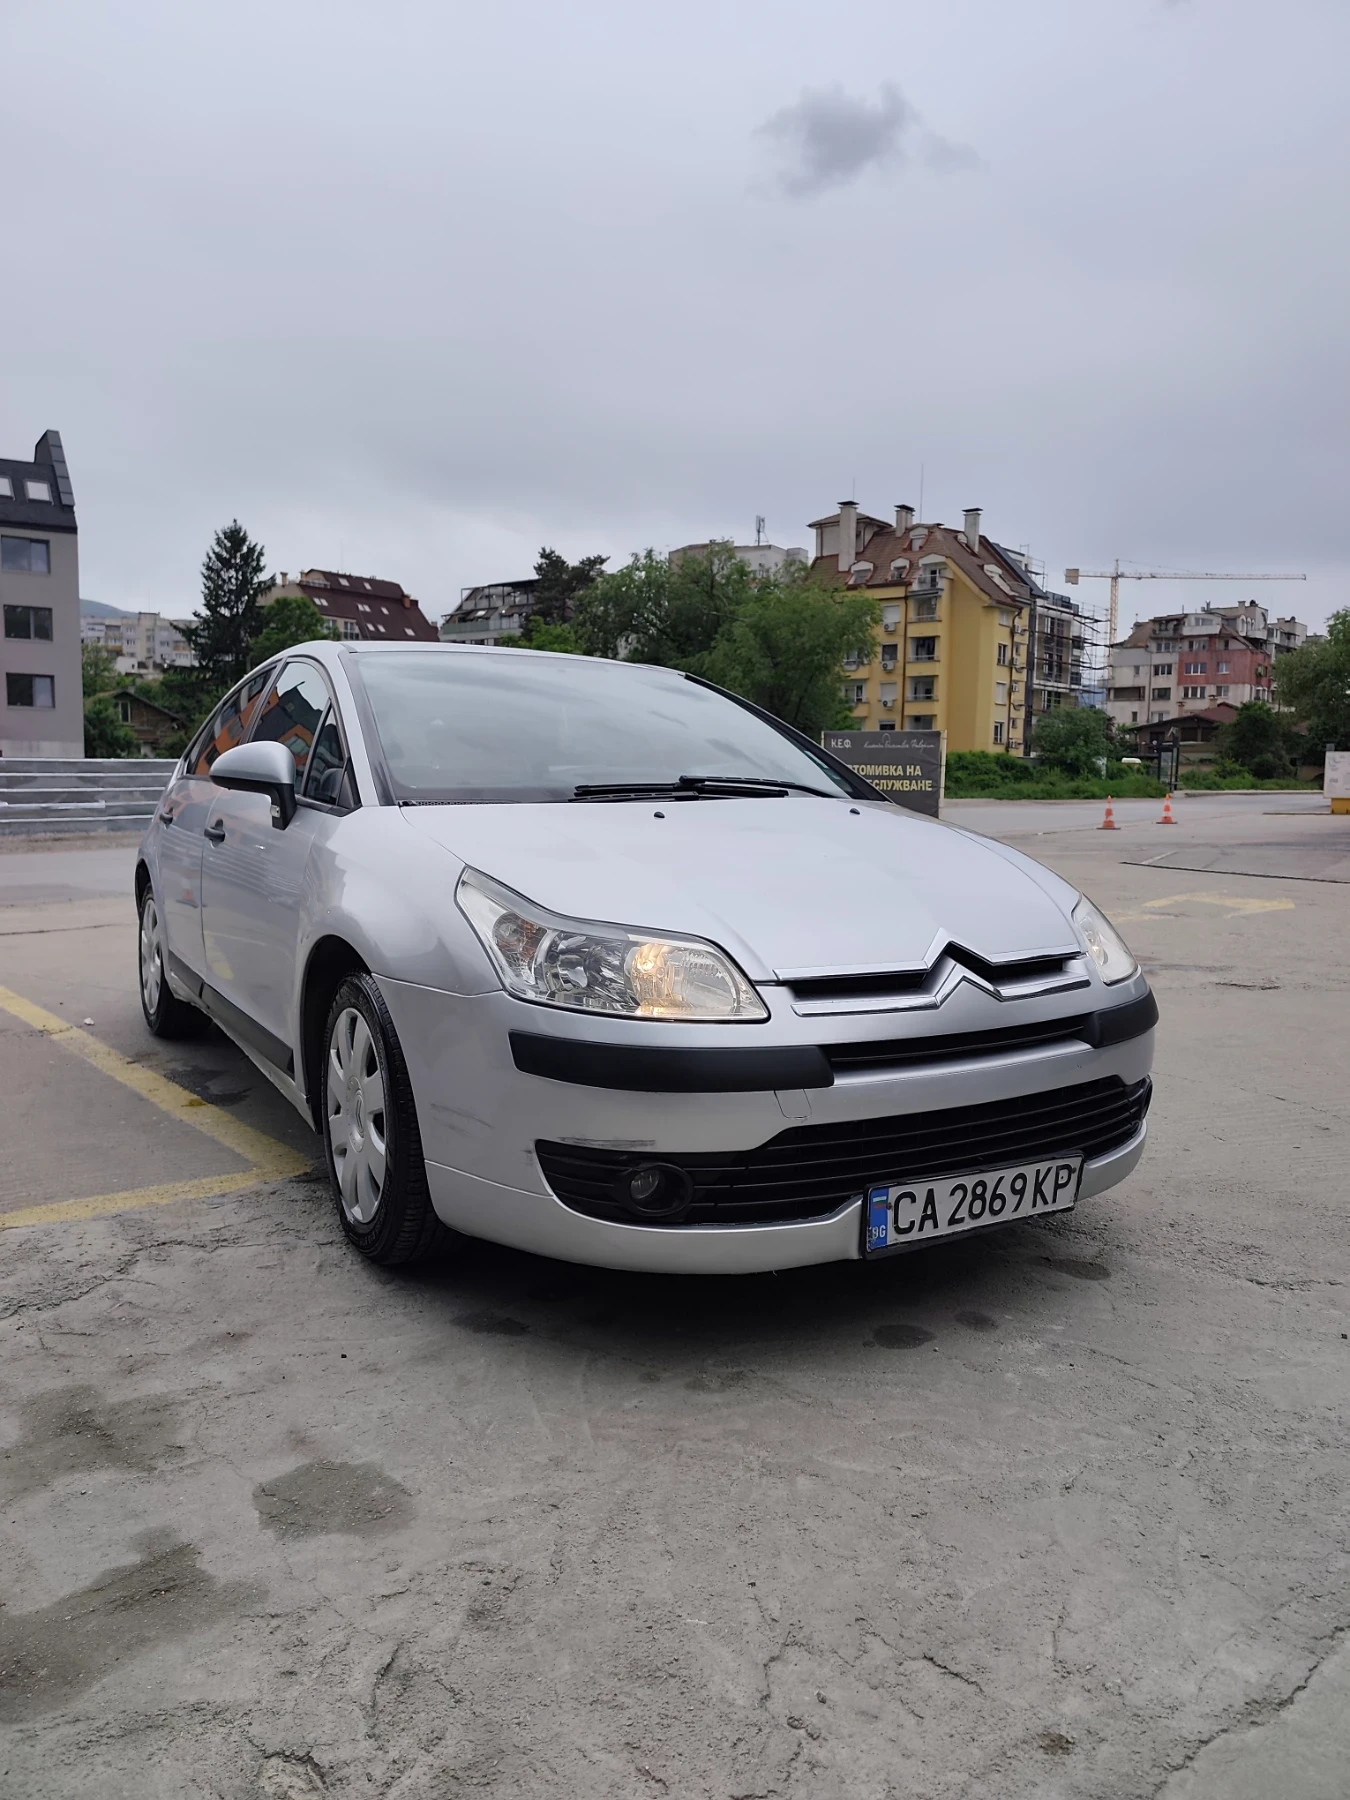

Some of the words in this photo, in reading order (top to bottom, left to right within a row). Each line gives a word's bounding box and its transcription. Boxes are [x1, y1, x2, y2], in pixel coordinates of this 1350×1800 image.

[906, 764, 922, 776] НА
[893, 1187, 939, 1235] CA
[947, 1172, 1028, 1227] 2869
[872, 1224, 886, 1239] BG
